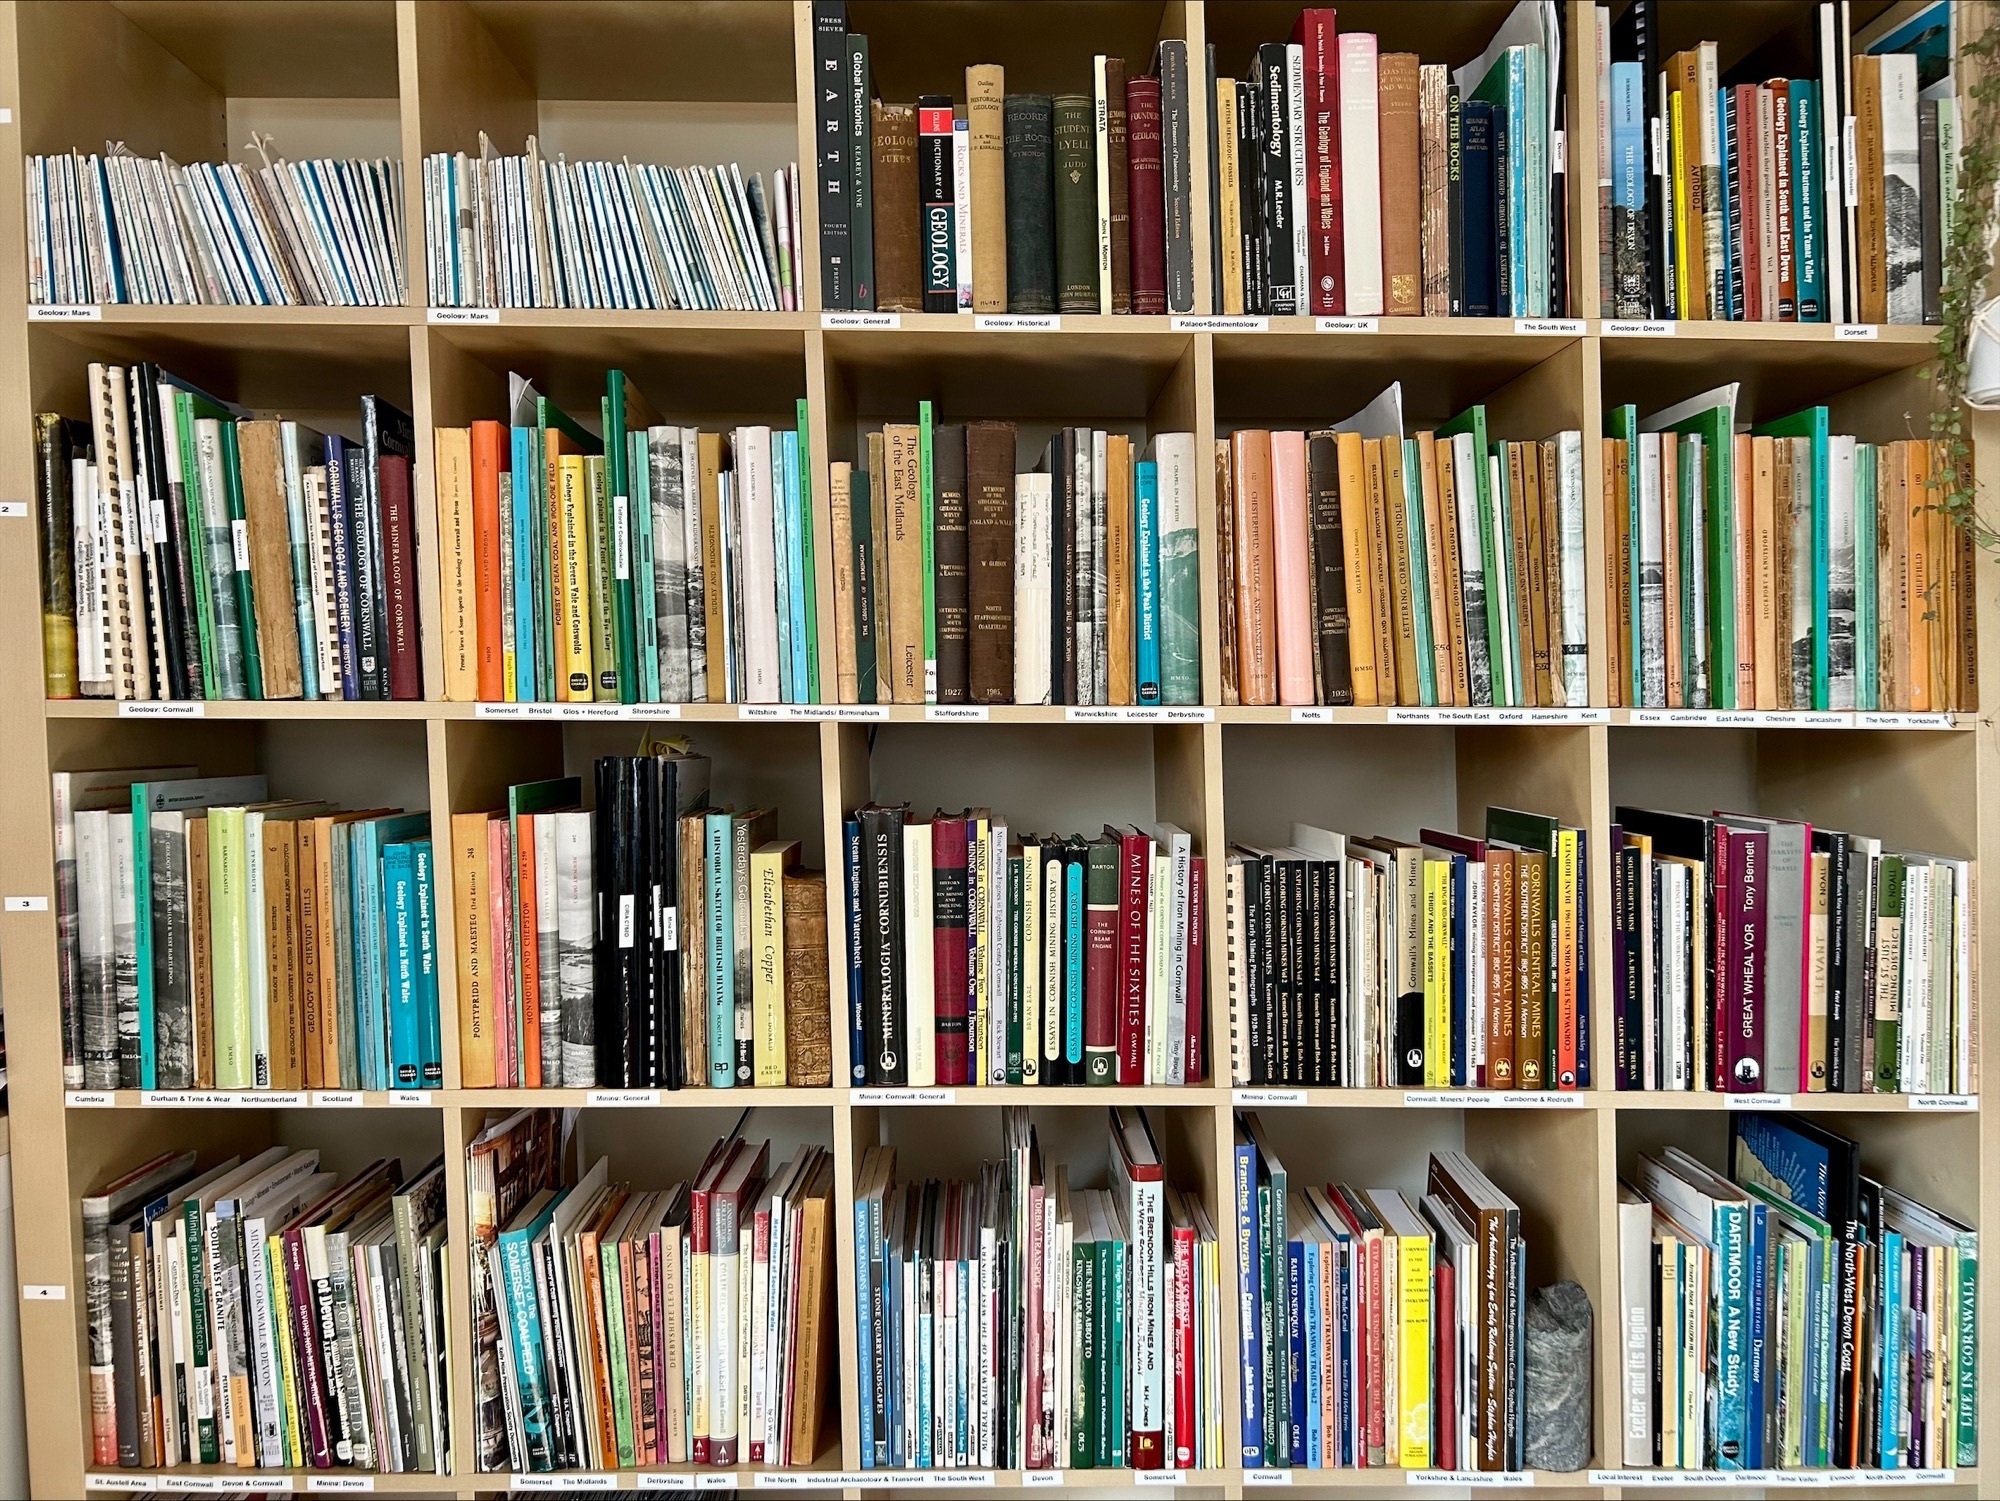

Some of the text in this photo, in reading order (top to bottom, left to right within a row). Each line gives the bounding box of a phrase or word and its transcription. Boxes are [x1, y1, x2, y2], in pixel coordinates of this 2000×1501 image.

[853, 52, 864, 136] Global Tectonics
[1098, 99, 1106, 132] STRATA
[1269, 66, 1281, 157] Sedimentology
[1776, 97, 1786, 132] Geology
[825, 59, 840, 194] EARTH
[1450, 95, 1460, 181] ON THE ROCKS
[934, 138, 942, 199] DICTIONARY OF
[1776, 134, 1788, 181] Explained
[1274, 180, 1284, 229] M.R.Leeder
[1692, 165, 1700, 211] TORQUAY
[1779, 189, 1788, 213] South
[930, 207, 950, 288] GEOLOGY
[1780, 216, 1789, 232] and
[1780, 234, 1789, 252] East
[1780, 254, 1789, 282] Devon
[893, 436, 899, 446] of
[894, 469, 903, 491] East
[906, 436, 917, 501] The Geology
[895, 494, 905, 541] Midlands
[391, 525, 401, 585] MINERALOGY
[394, 589, 401, 600] OF
[395, 604, 405, 653] CORNWALL
[906, 645, 915, 688] Leicester
[764, 868, 775, 984] Elizabethan Copper
[877, 834, 892, 1039] MINERALOGIA CORNUBIENSIS
[1130, 854, 1141, 1025] MINES OF THE SIXTIES
[1743, 841, 1757, 1038] GREAT WHEAL VOR Tony Bennett
[307, 972, 314, 984] OF
[210, 1226, 224, 1330] SOUTH WEST GRANITE
[1724, 1212, 1742, 1396] DARTMOOR A New Study
[1961, 1277, 1974, 1427] LIFE IN CORNWALL
[875, 1357, 883, 1414] LANDSCAPES
